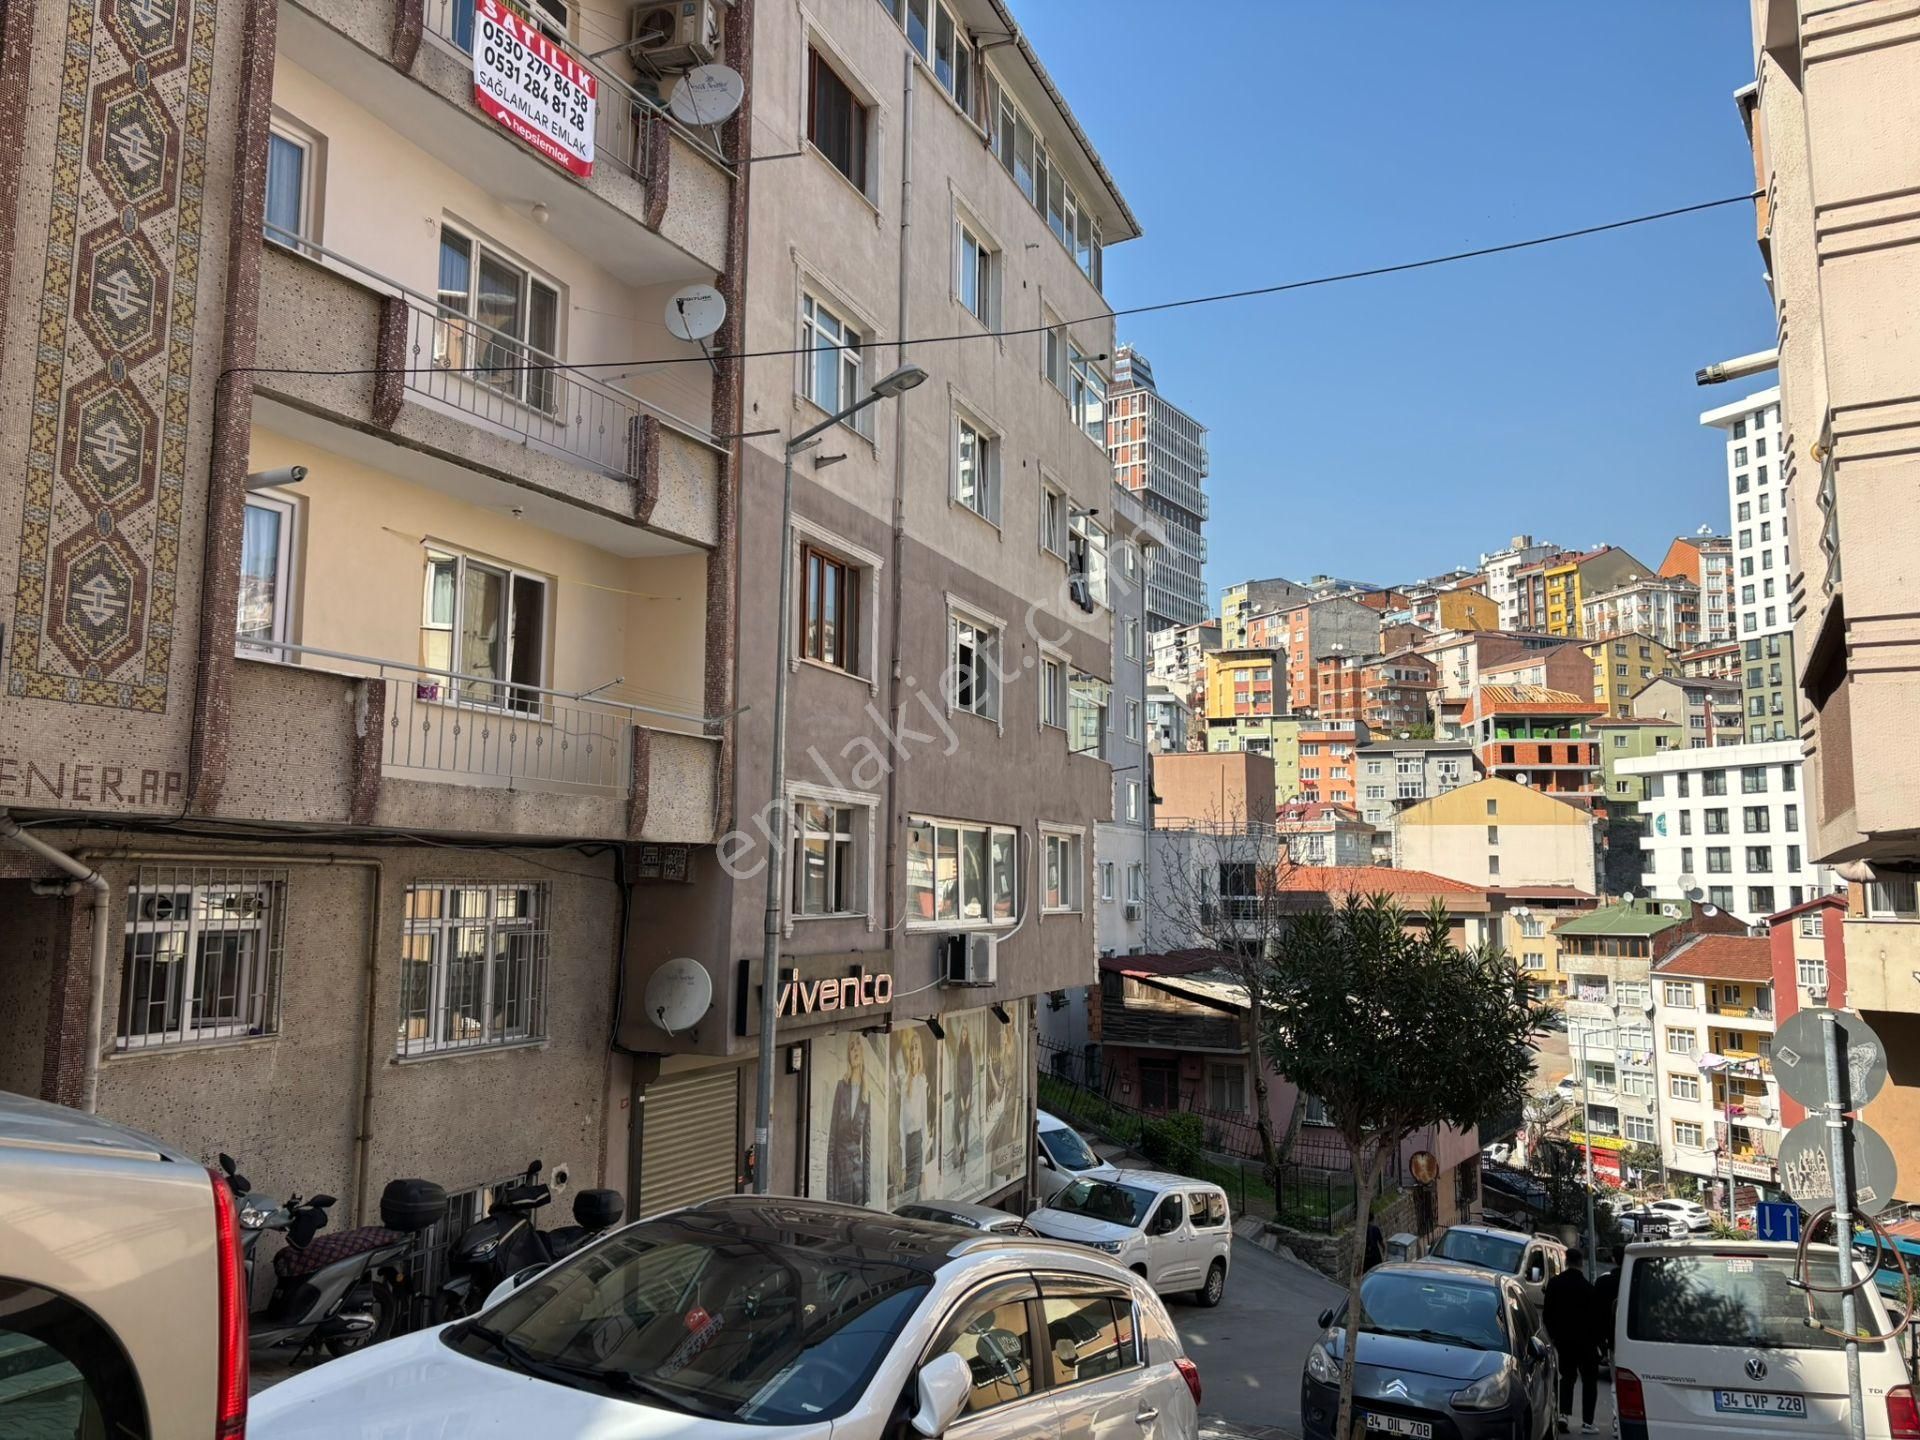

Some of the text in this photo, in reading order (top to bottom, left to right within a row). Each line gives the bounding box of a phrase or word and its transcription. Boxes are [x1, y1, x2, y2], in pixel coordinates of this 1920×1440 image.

[483, 21, 588, 113] 0530 279 86 58
[484, 0, 592, 93] SATILIK
[479, 70, 586, 156] SAĞLAMLAR EMLAK
[484, 46, 585, 132] 0531 284 81 28
[512, 119, 569, 165] hepsiemlak
[1642, 1224, 1668, 1233] EFOR
[1368, 1414, 1380, 1427] 34
[1410, 1421, 1430, 1437] 708
[1722, 1393, 1801, 1411] 34 CVP 228
